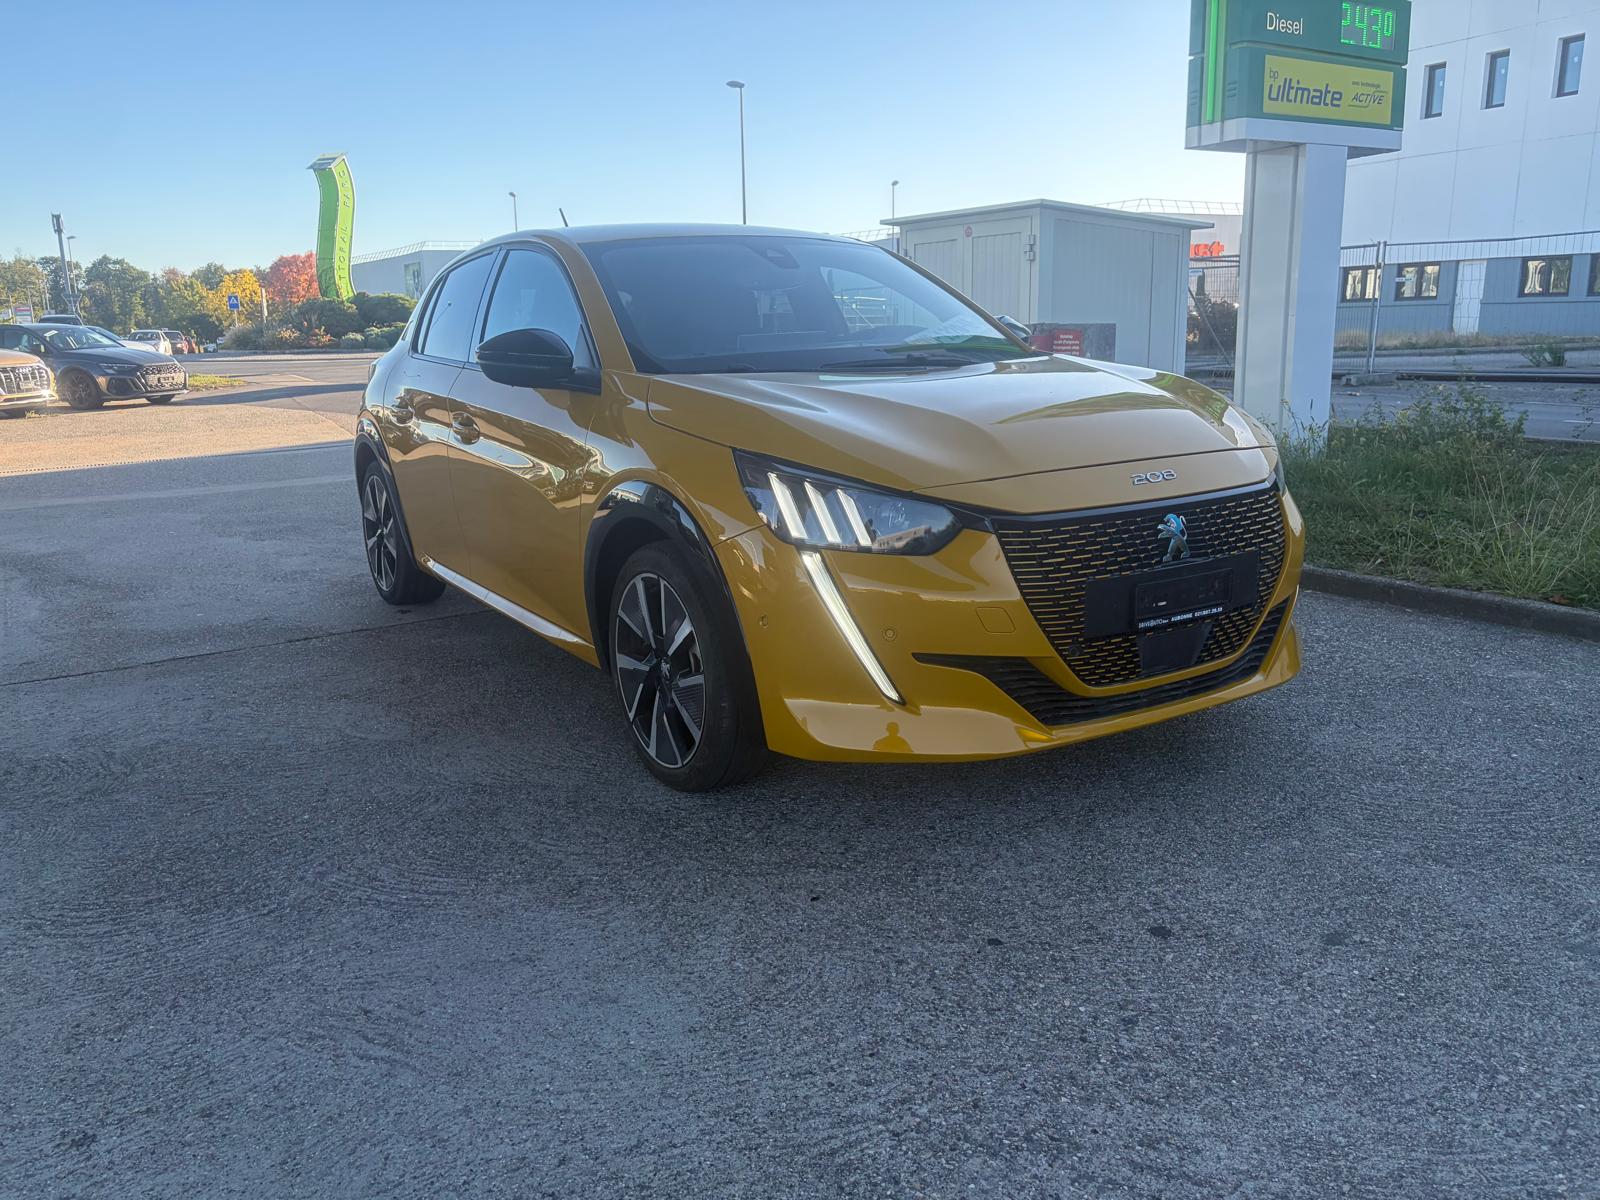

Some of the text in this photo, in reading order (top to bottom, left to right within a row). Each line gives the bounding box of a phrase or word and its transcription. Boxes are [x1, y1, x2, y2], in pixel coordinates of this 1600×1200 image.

[1266, 12, 1303, 35] Diesel
[1269, 67, 1279, 82] bp
[1268, 78, 1343, 107] ultimate
[1352, 92, 1384, 105] ACTIVE
[1131, 469, 1177, 486] 208
